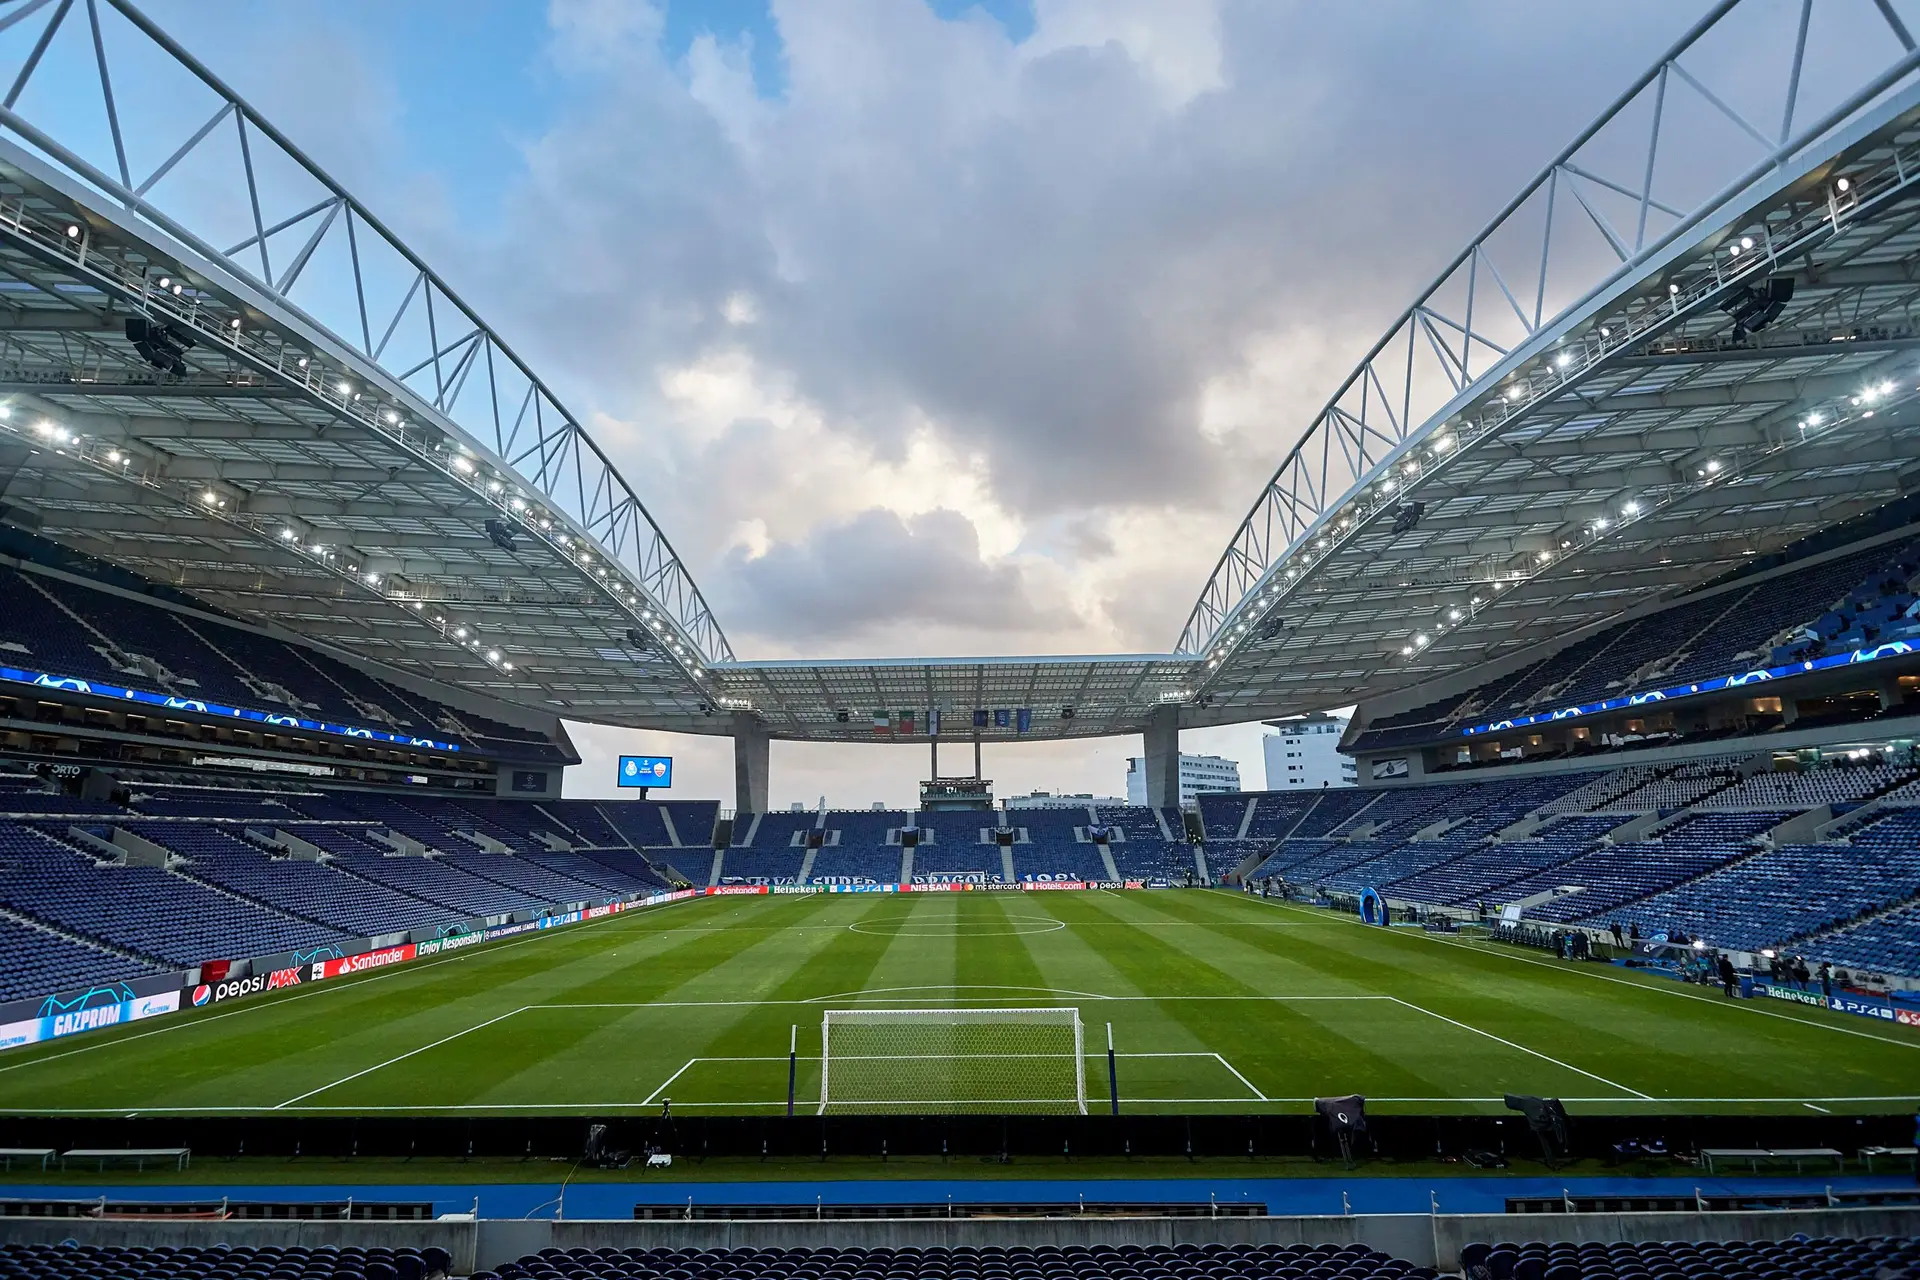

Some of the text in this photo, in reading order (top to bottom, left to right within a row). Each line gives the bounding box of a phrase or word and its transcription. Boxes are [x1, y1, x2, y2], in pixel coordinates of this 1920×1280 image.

[46, 763, 81, 775] ORTO
[722, 886, 761, 895] Santander
[773, 885, 817, 894] Heineken
[910, 883, 951, 892] NISSAN
[1035, 882, 1082, 890] Hotels.com
[1099, 882, 1124, 891] pepsi
[588, 905, 611, 918] NISSAN
[553, 914, 571, 926] PS4
[500, 924, 522, 936] CHAMPIONS
[418, 930, 484, 956] Enjoy Responsibly
[351, 949, 405, 972] Santander
[215, 965, 304, 1003] pepsi MAX
[1768, 985, 1817, 1005] Heineken
[1847, 1002, 1880, 1017] PS4
[53, 1004, 121, 1036] GAZPROM
